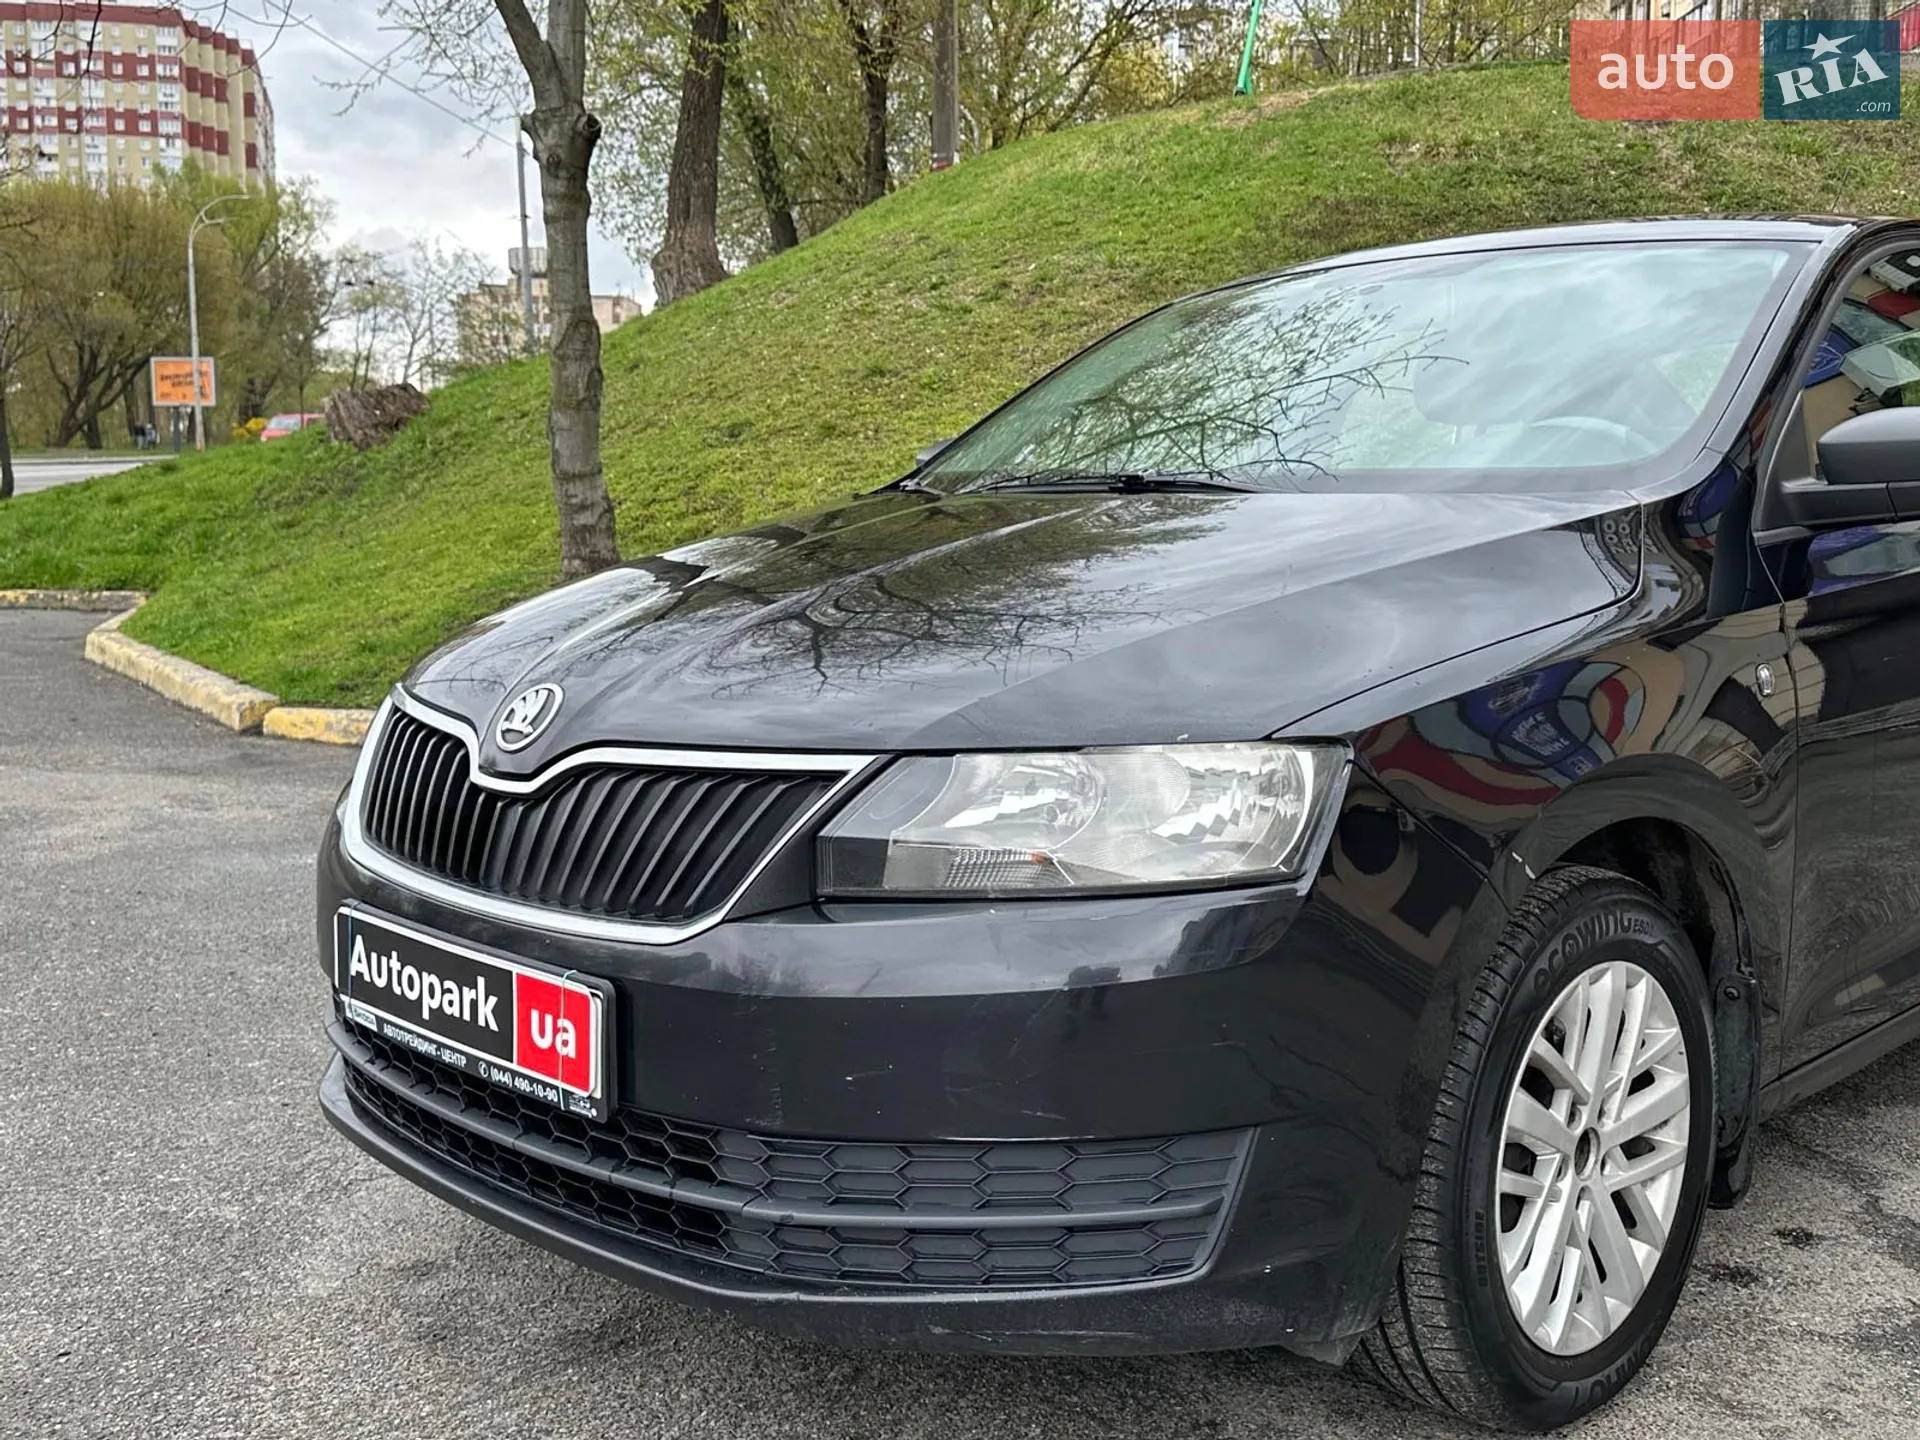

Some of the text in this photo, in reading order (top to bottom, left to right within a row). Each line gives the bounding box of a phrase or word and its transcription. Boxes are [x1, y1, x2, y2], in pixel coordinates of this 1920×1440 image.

[350, 934, 499, 1032] Autopark
[531, 1009, 577, 1058] ua
[490, 1065, 558, 1102] (044) 490-10-90
